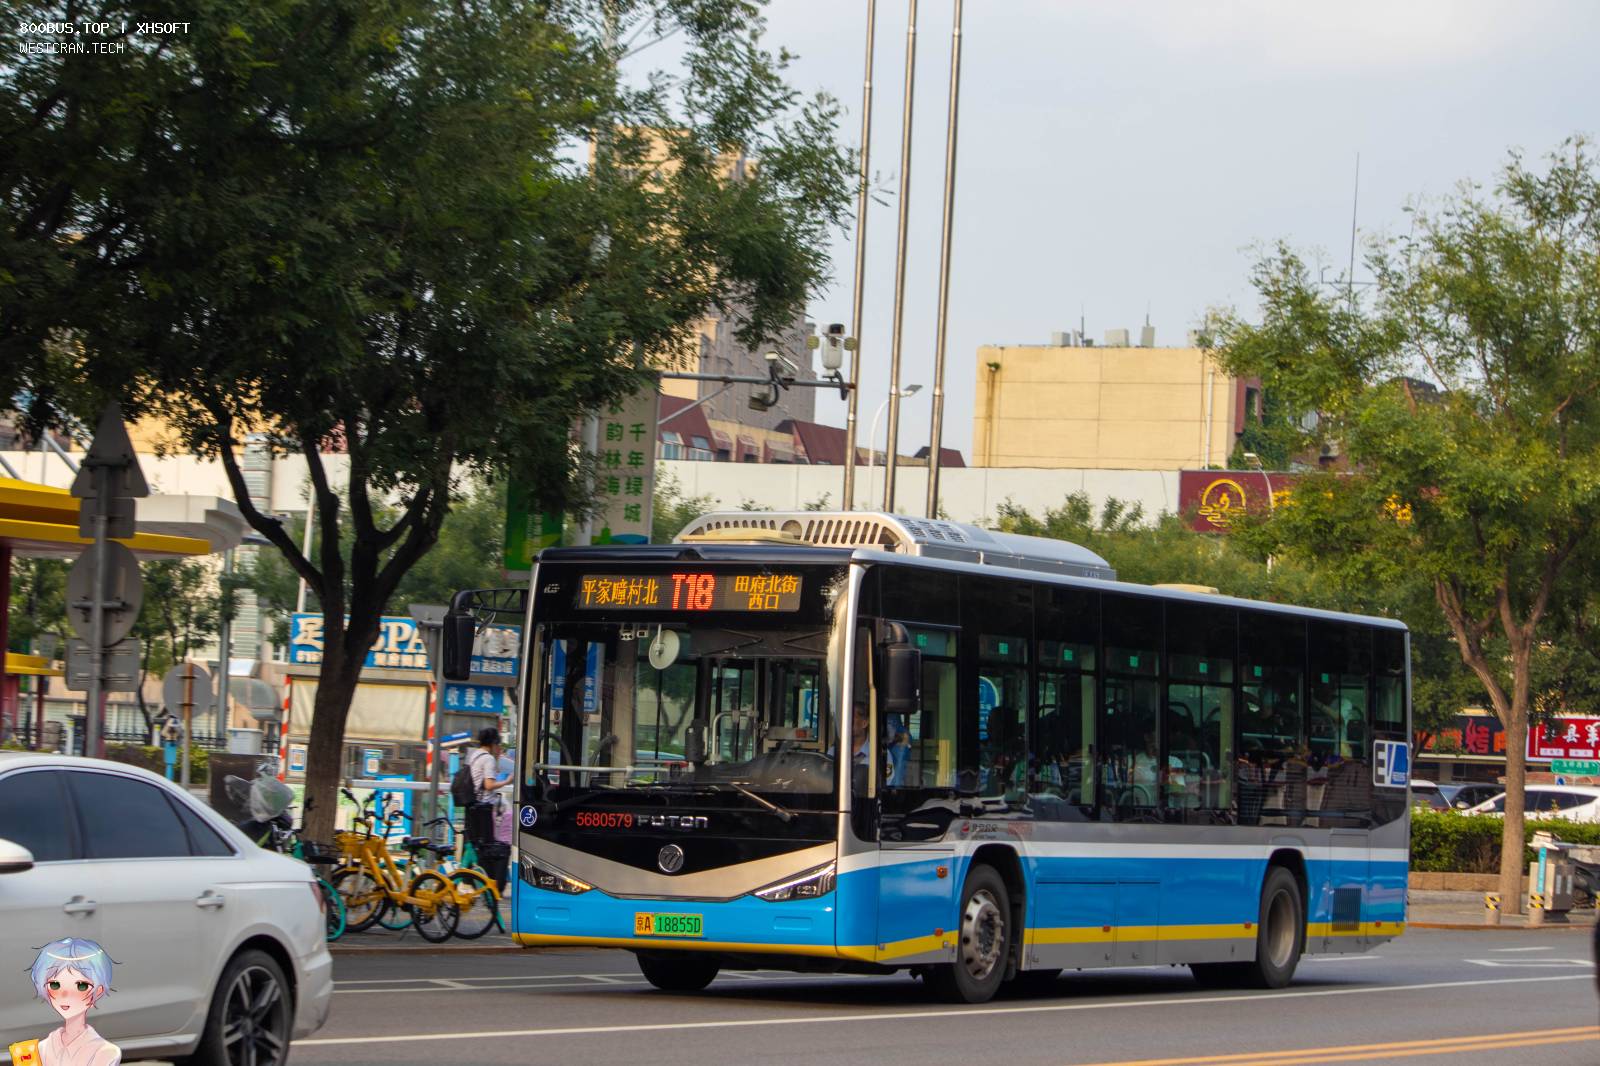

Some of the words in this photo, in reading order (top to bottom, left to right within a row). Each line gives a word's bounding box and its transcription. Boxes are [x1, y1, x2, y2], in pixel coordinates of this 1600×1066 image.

[671, 574, 716, 610] T18
[734, 575, 799, 594] 田府北街
[748, 593, 779, 610] 西口
[575, 812, 632, 827] 5680579
[637, 815, 709, 829] FOTON
